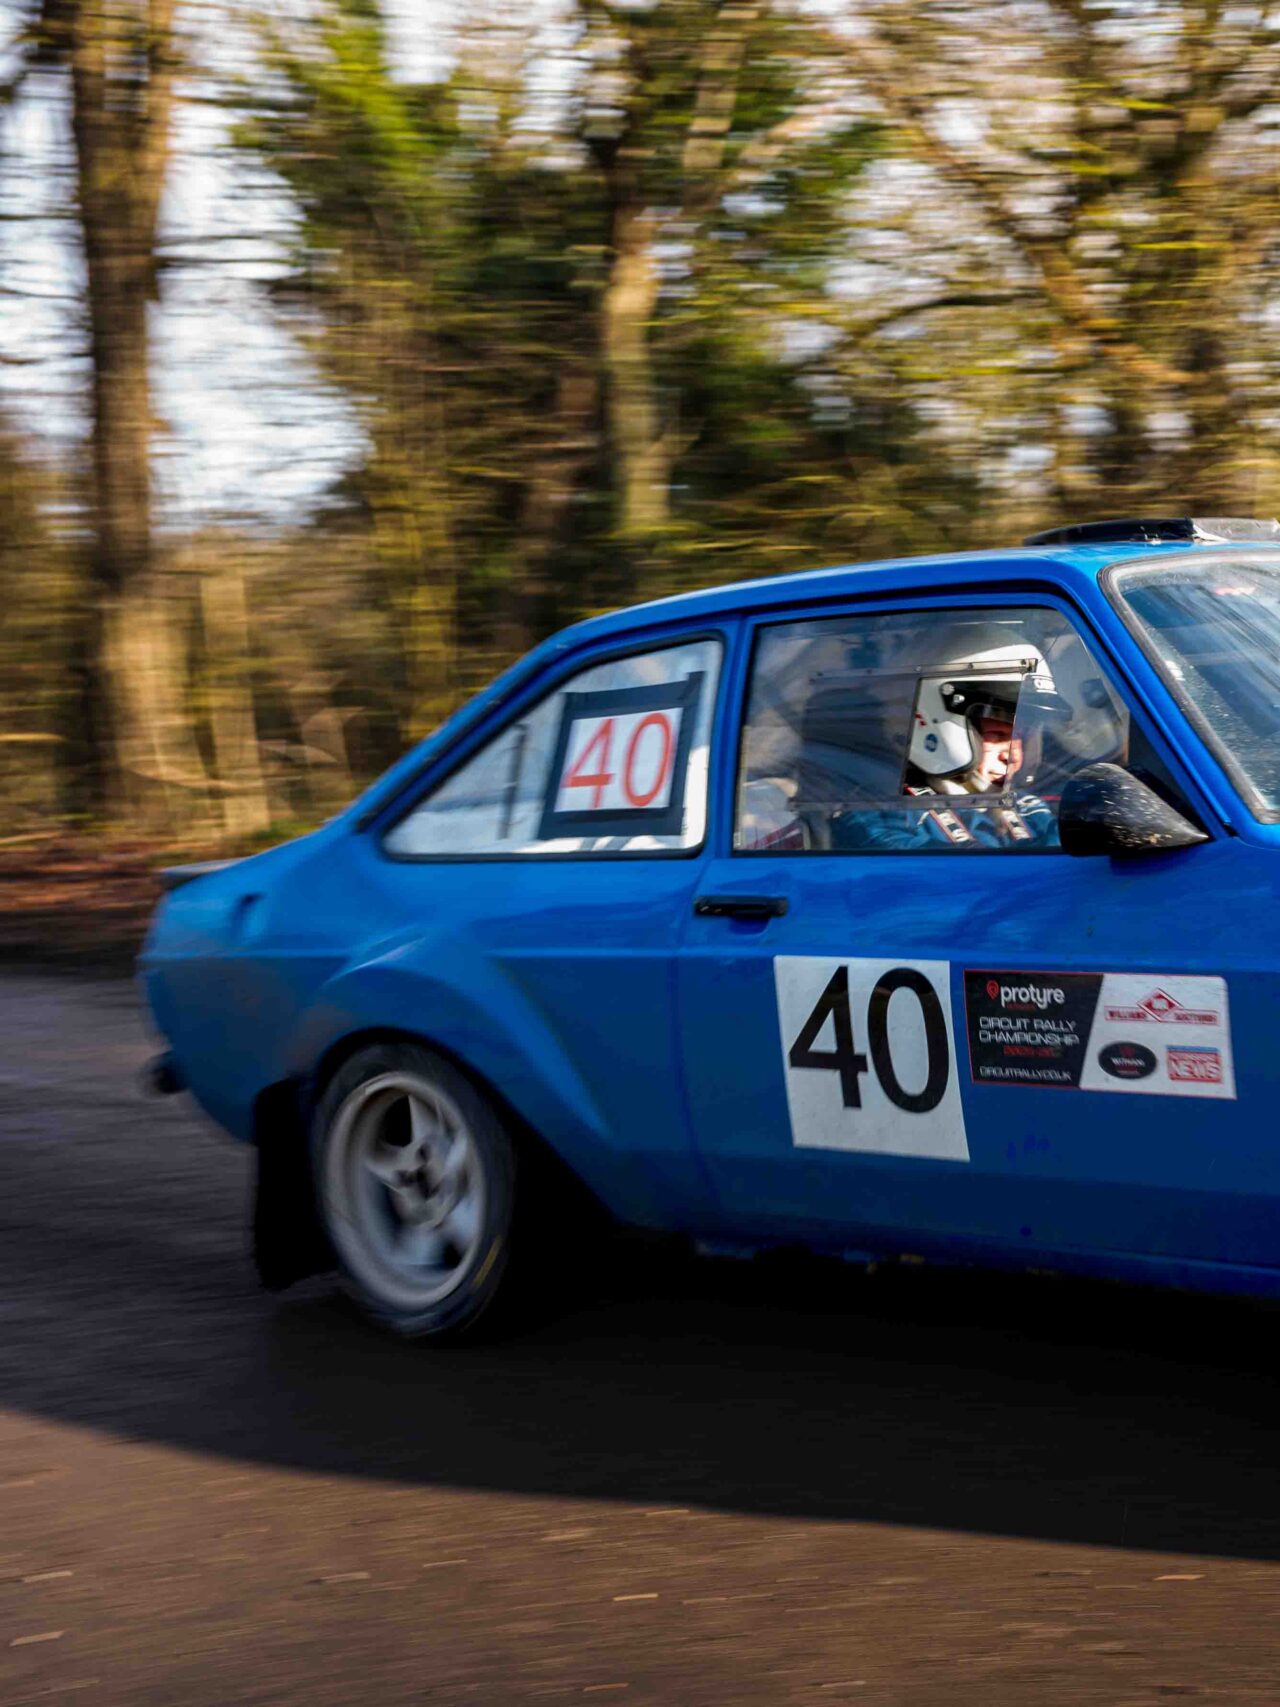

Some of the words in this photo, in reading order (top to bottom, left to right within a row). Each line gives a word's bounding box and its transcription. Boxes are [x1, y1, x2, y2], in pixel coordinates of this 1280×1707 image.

[562, 711, 674, 810] 40
[1000, 983, 1065, 1010] protyre
[979, 1016, 1031, 1030] CIRCUIT
[1033, 1018, 1076, 1033] RALLY
[789, 964, 949, 1114] 40
[979, 1029, 1080, 1047] CHAMPIONSHIP
[1167, 1058, 1222, 1079] NEWS
